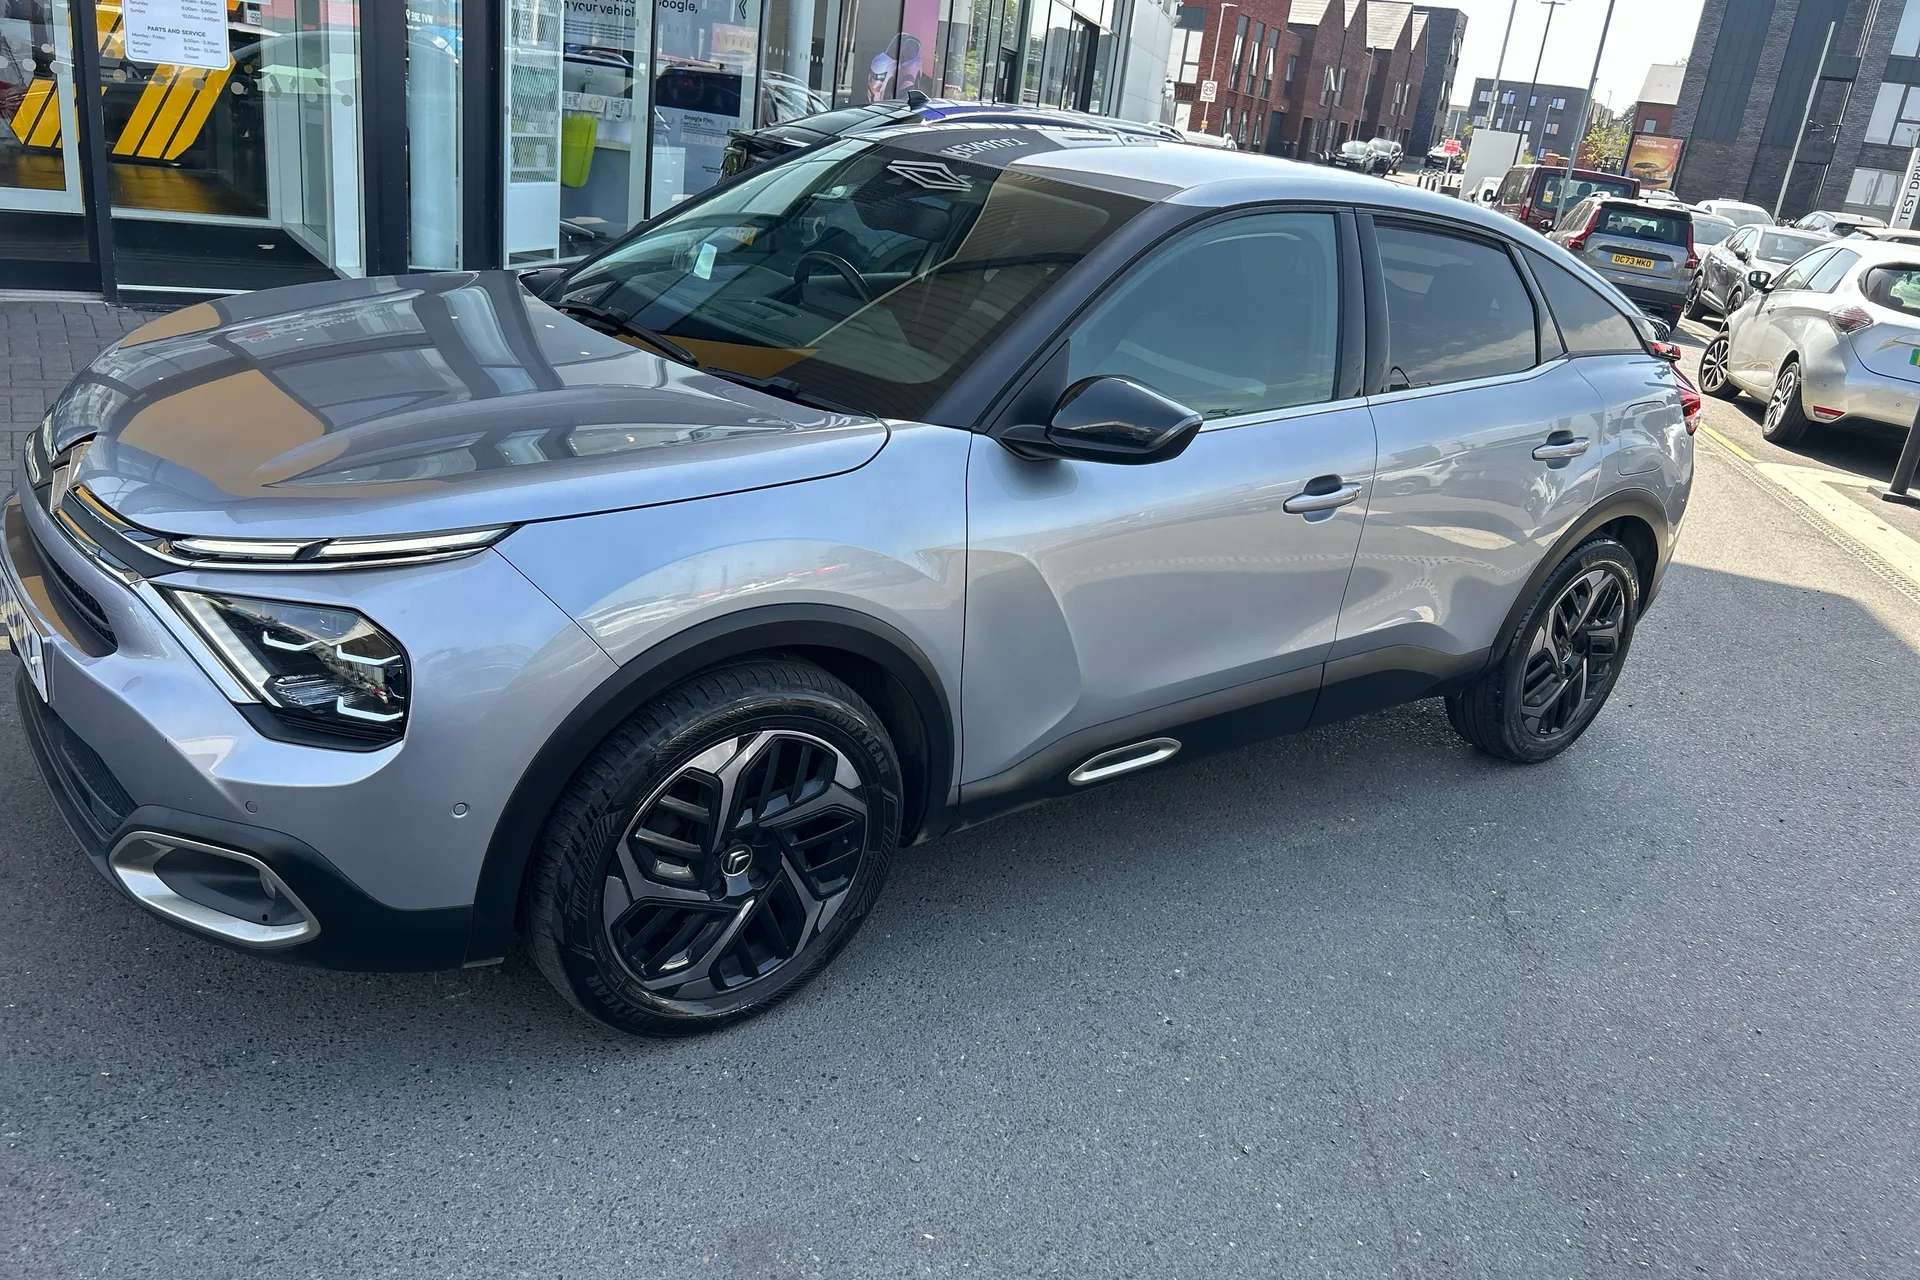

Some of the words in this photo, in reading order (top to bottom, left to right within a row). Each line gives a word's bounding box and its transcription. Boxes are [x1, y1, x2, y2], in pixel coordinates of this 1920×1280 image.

[573, 2, 597, 12] your
[600, 5, 635, 17] vehicl
[1899, 192, 1916, 221] TEST
[1614, 255, 1635, 265] DC73
